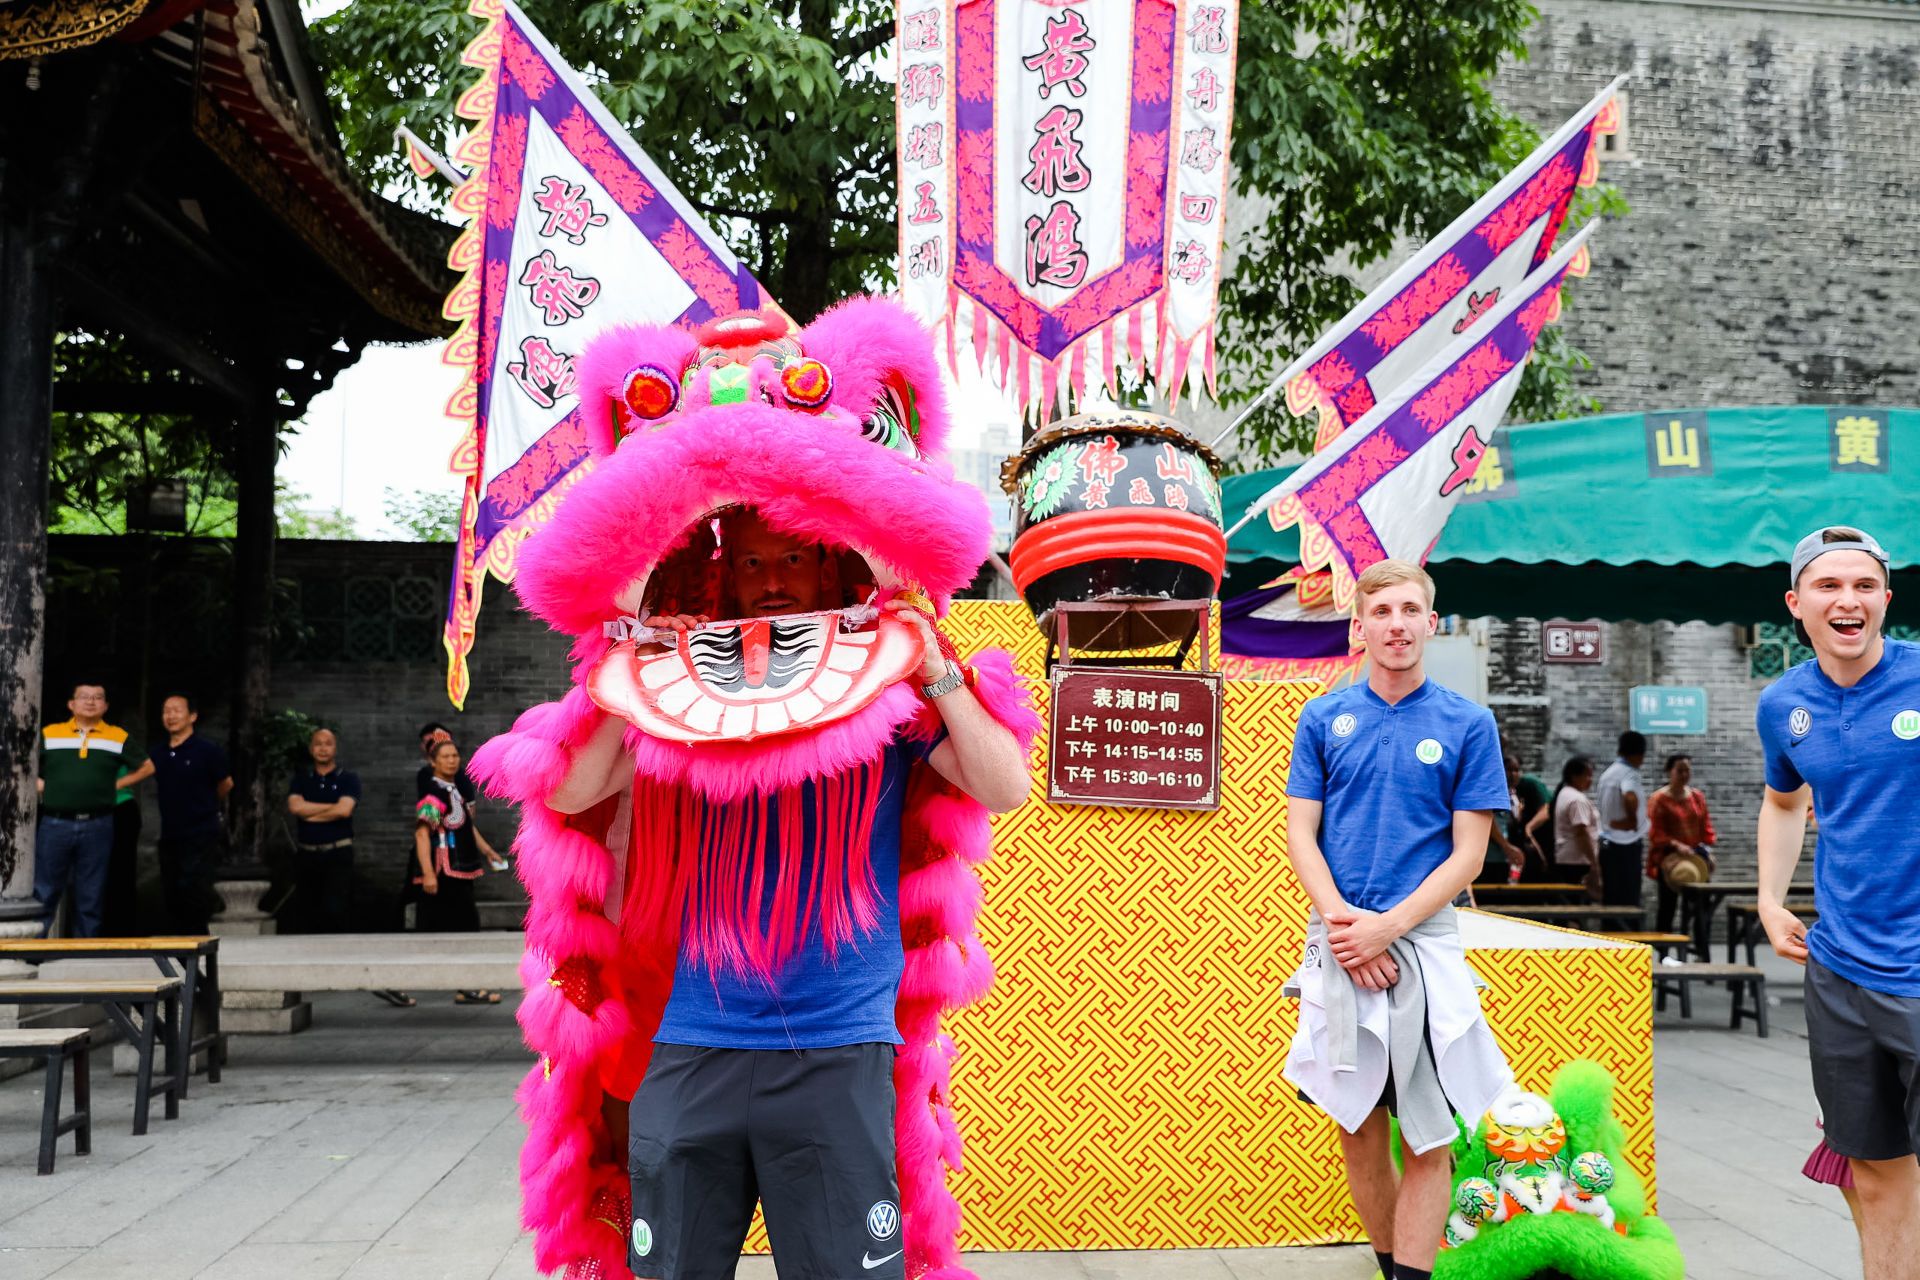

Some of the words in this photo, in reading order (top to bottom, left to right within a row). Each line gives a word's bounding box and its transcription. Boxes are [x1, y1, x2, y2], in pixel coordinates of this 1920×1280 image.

[1077, 435, 1193, 486] 佛山
[1092, 687, 1180, 712] 表演时间
[1065, 715, 1098, 733] 上午
[1104, 718, 1204, 737] 10:00-10:40
[1065, 740, 1097, 758] 下午
[1103, 743, 1203, 762] 14:15-14:55
[1064, 765, 1096, 784] 下午
[1102, 769, 1203, 787] 15:30-16:10
